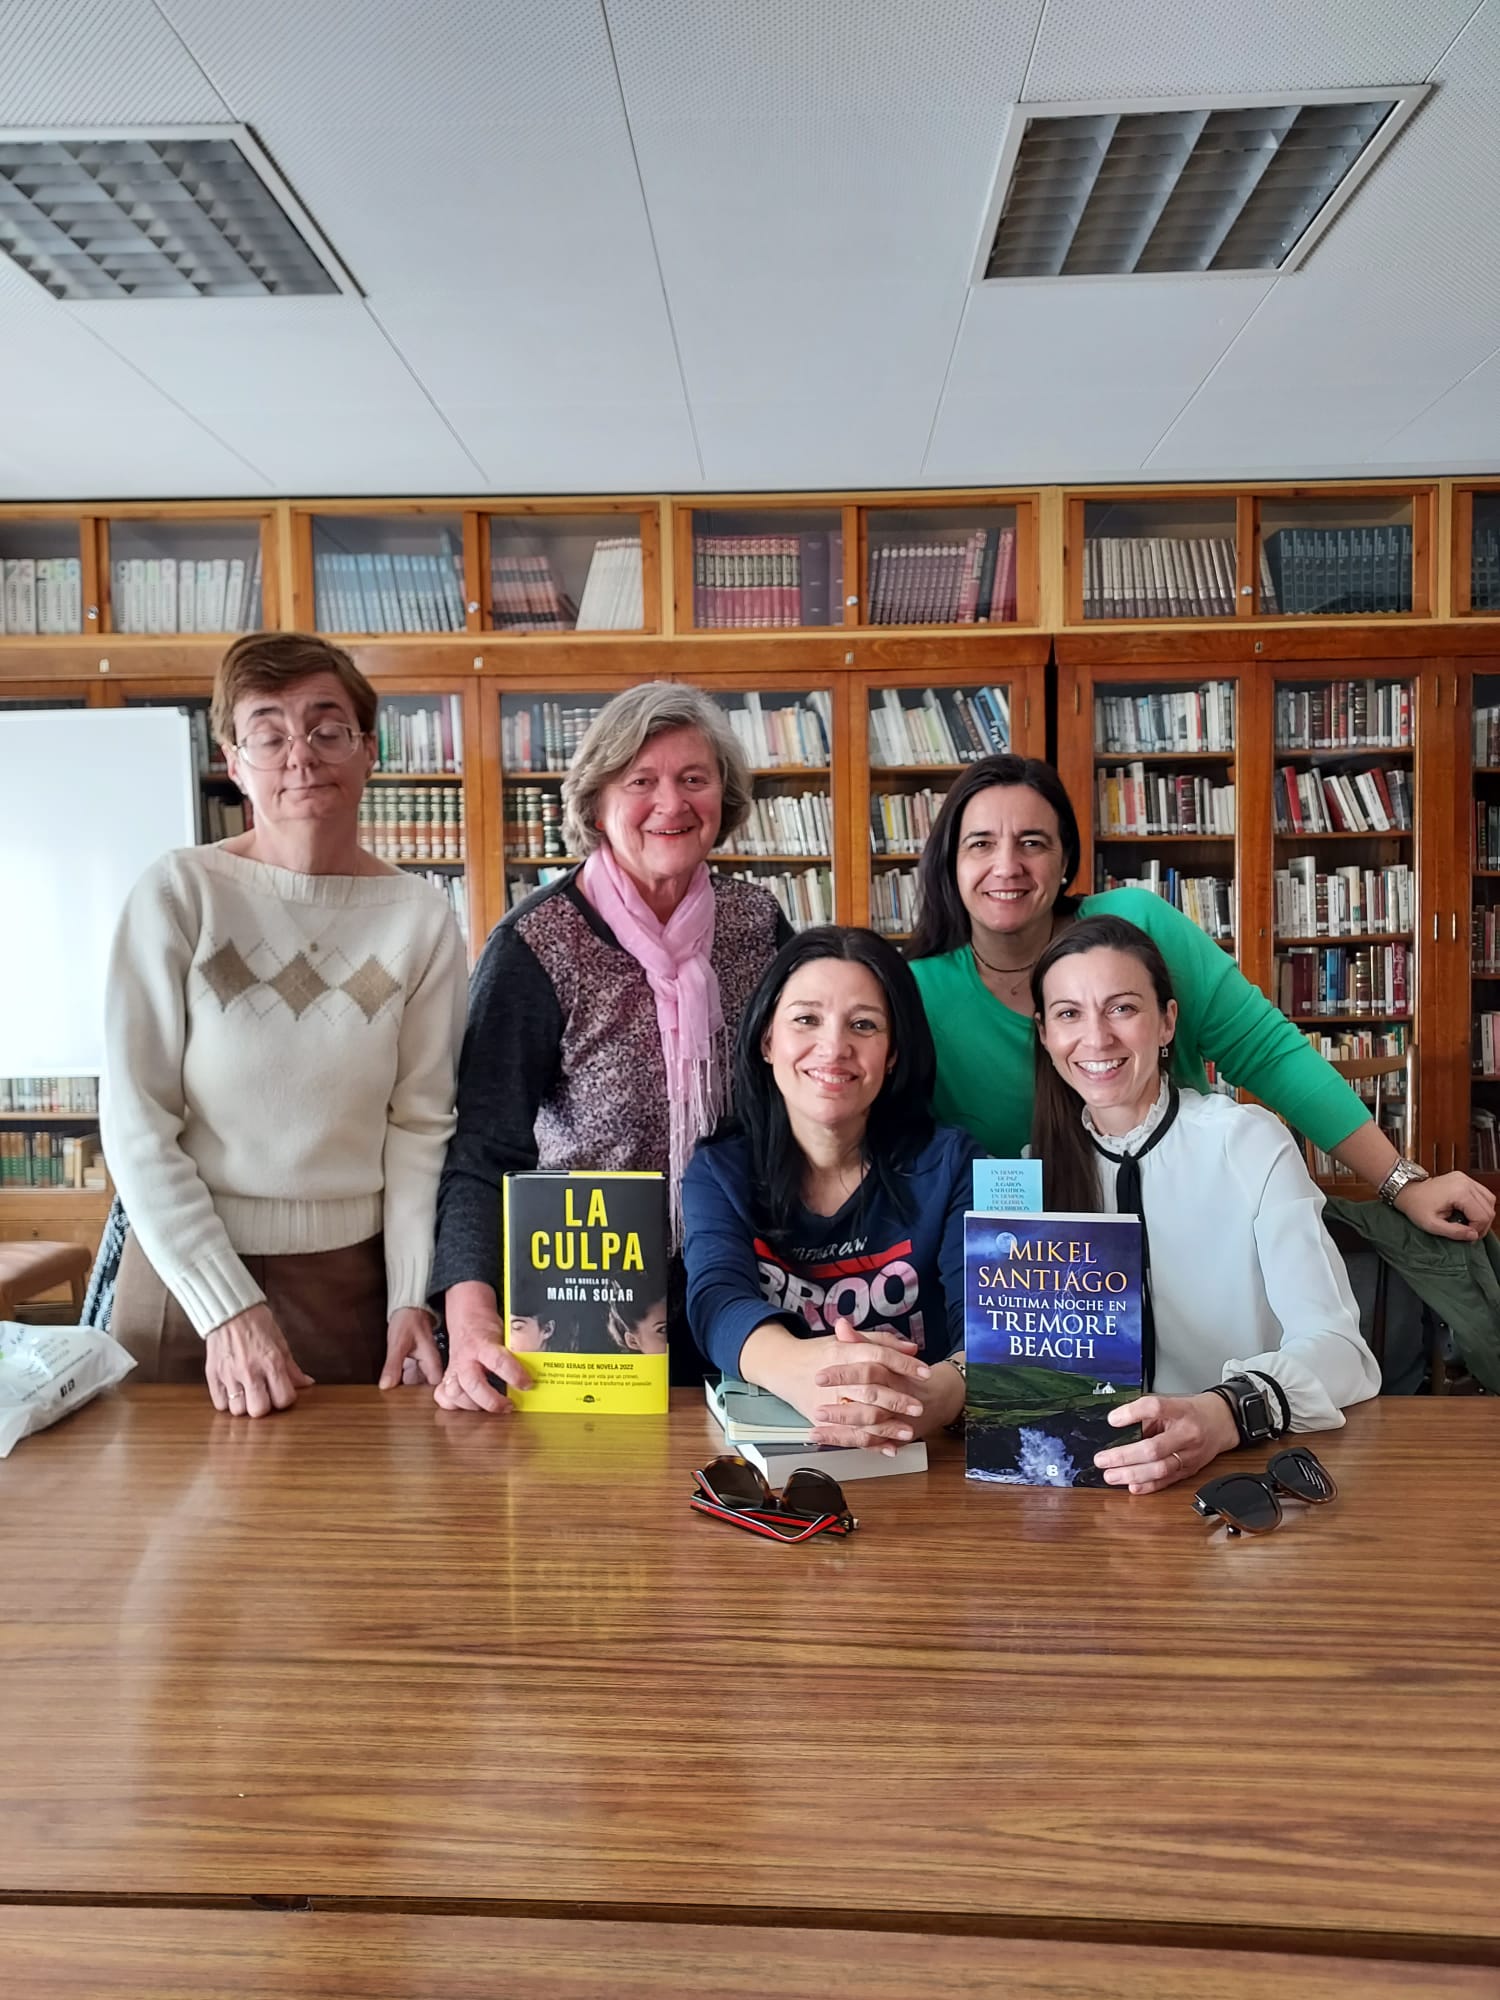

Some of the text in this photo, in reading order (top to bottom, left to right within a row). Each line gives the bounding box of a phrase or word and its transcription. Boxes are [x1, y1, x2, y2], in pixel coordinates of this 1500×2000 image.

[565, 1188, 608, 1228] LA
[531, 1230, 645, 1271] CULPA
[1008, 1240, 1097, 1264] MIKEL
[978, 1266, 1128, 1293] SANTIAGO
[547, 1285, 634, 1302] MARÍA SOLAR
[978, 1294, 1127, 1312] LA ÚLTIMA NOCHE EN
[986, 1310, 1118, 1336] TREMORE
[1009, 1335, 1096, 1359] BEACH
